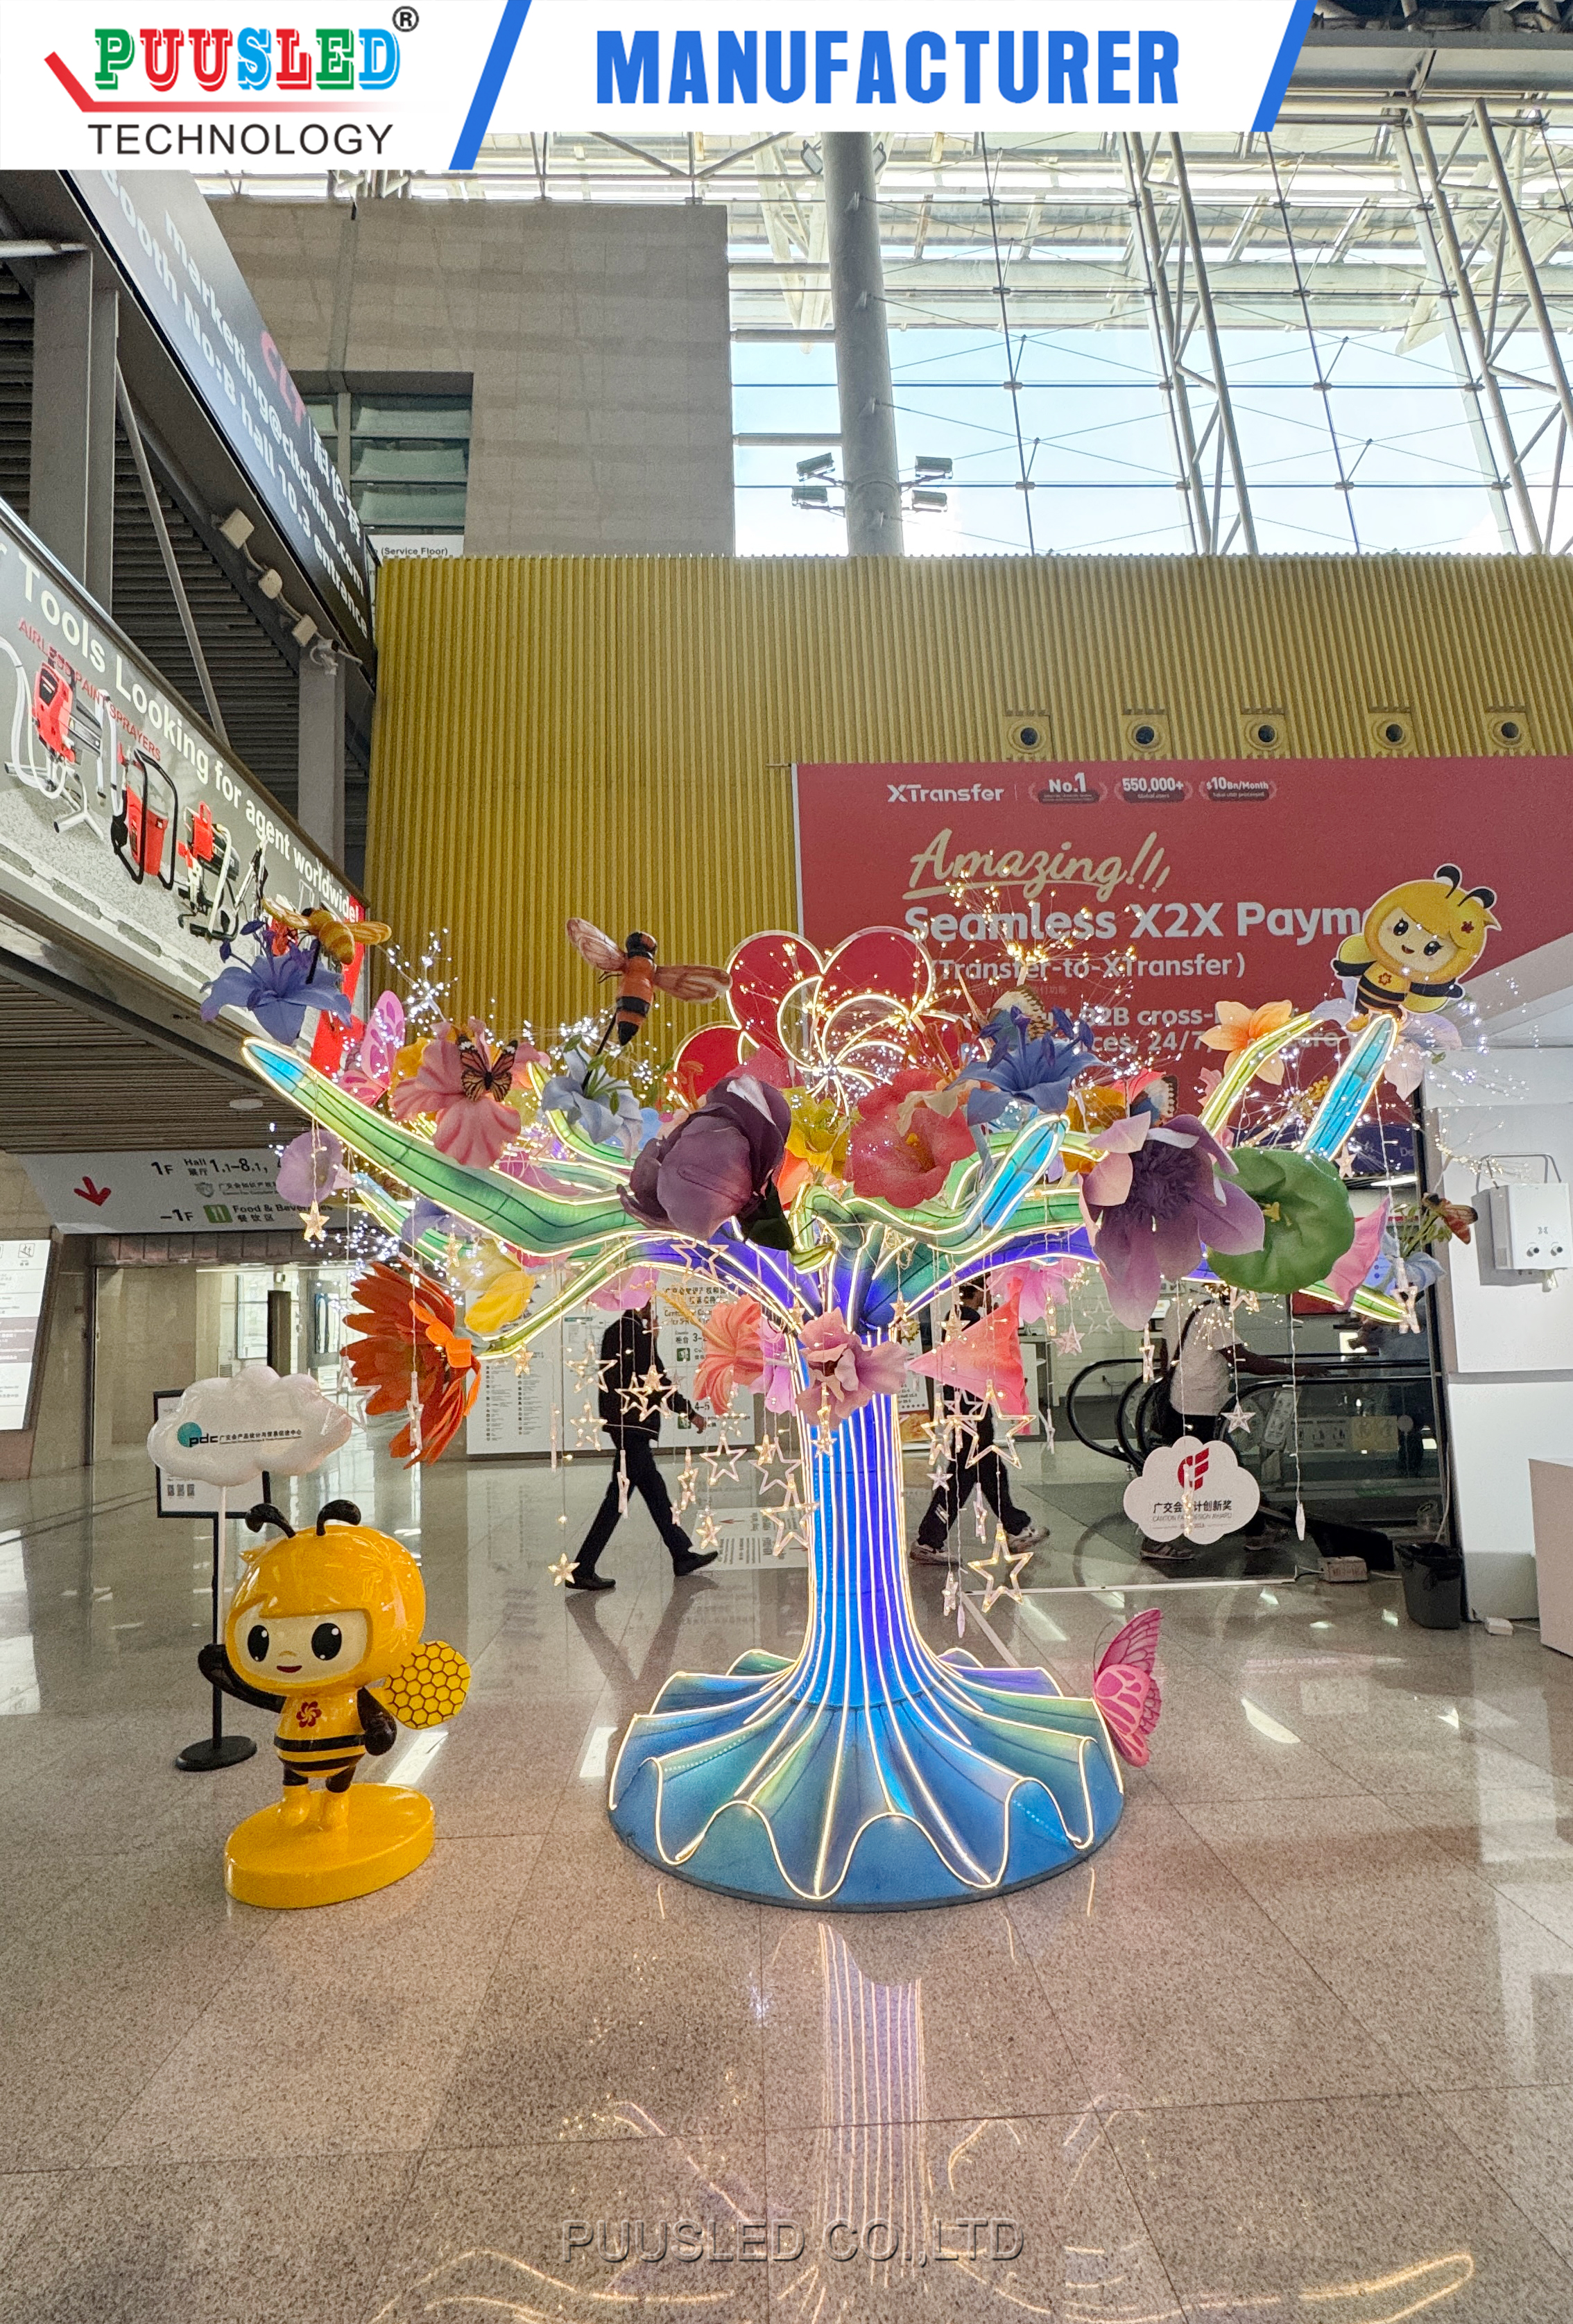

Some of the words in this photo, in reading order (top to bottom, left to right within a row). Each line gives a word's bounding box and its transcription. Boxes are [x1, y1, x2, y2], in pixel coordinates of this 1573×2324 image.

[165, 210, 364, 598] marketing@cltchina.com
[240, 392, 276, 478] hall
[278, 464, 311, 538] 10.3
[313, 533, 368, 639] entrance
[381, 547, 418, 556] (Service
[421, 547, 448, 556] Floor)
[19, 551, 105, 673] Tools
[116, 653, 208, 785] Looking
[215, 760, 242, 809] for
[246, 799, 290, 861] agent
[110, 703, 161, 761] SPRAYERS
[1048, 772, 1086, 793] No.1
[886, 784, 1004, 803] XTransfer
[910, 827, 1171, 902] Amazing!!!
[904, 901, 1117, 941] Seamless
[1129, 902, 1224, 938] X2X
[1237, 902, 1364, 945] Paym
[1137, 1007, 1219, 1028] cross-
[151, 1162, 173, 1176] 1F
[232, 1205, 261, 1213] Food
[189, 1434, 218, 1447] pdc
[1153, 1499, 1232, 1514] 广交会计创新奖
